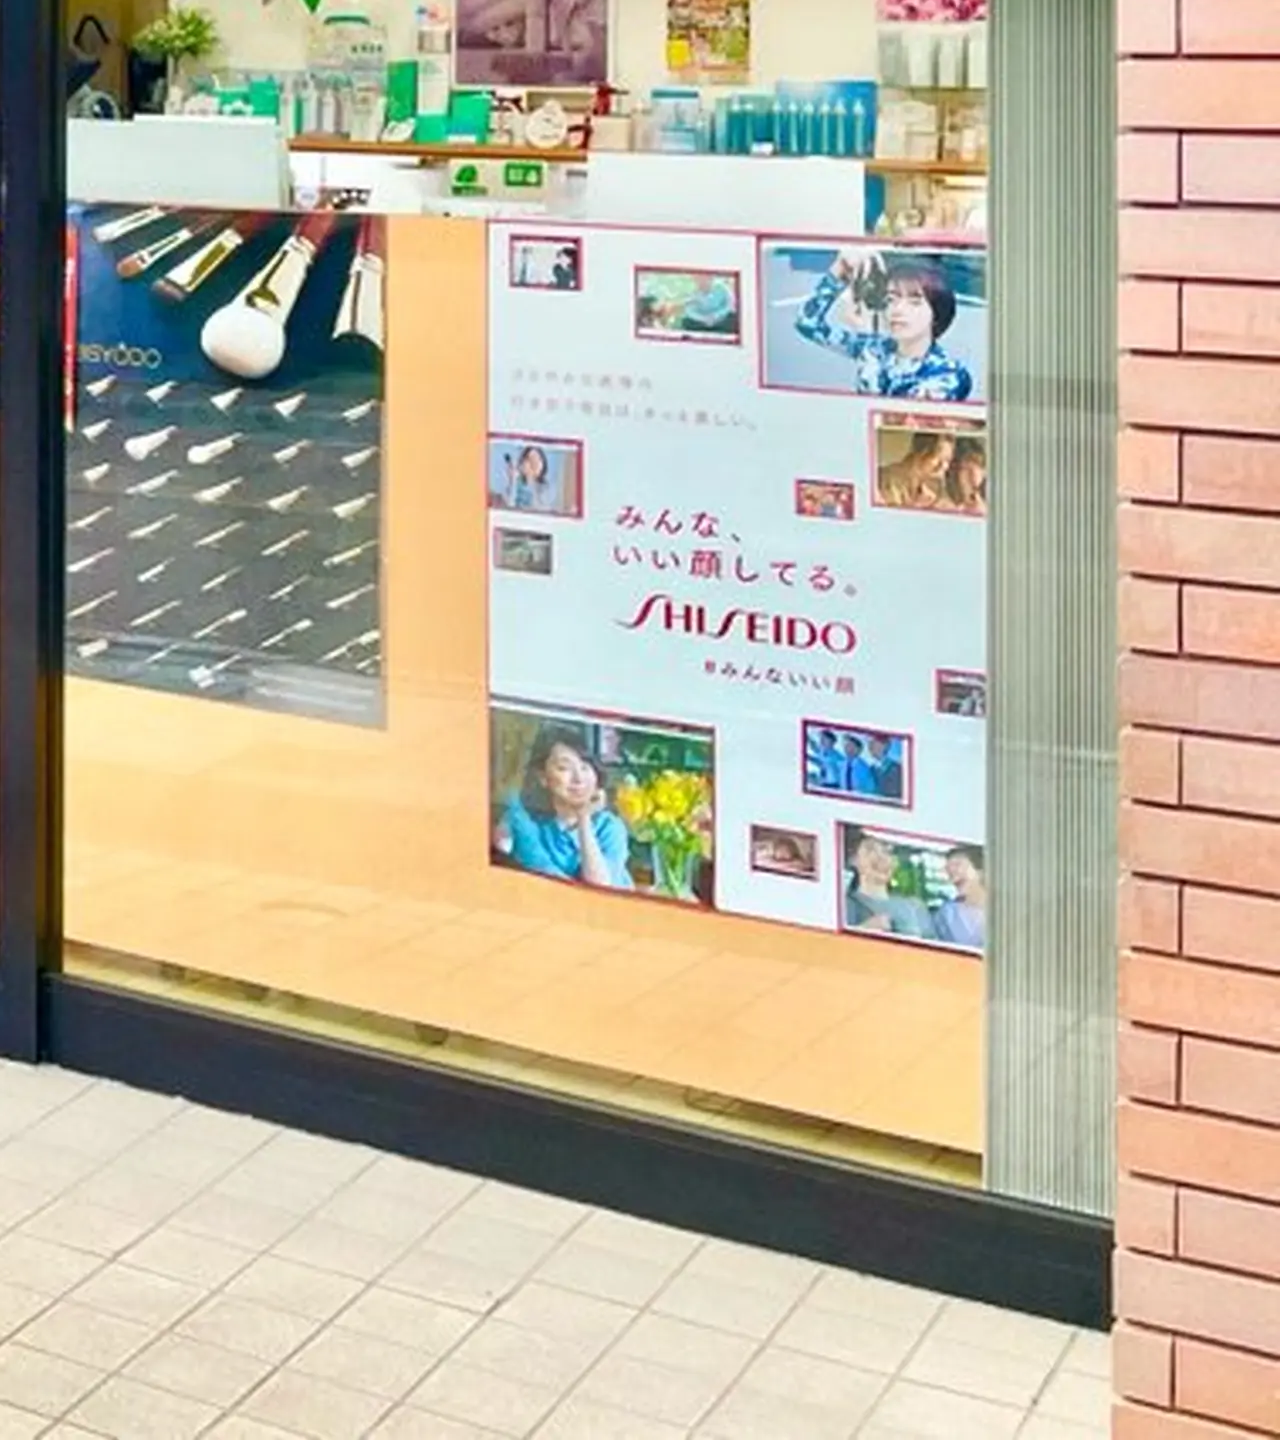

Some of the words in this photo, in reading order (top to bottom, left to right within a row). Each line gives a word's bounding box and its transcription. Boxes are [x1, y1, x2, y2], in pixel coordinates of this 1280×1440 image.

[616, 505, 740, 543] みんな、
[613, 545, 858, 598] いい顔してる。
[612, 593, 857, 654] SHISEIDO
